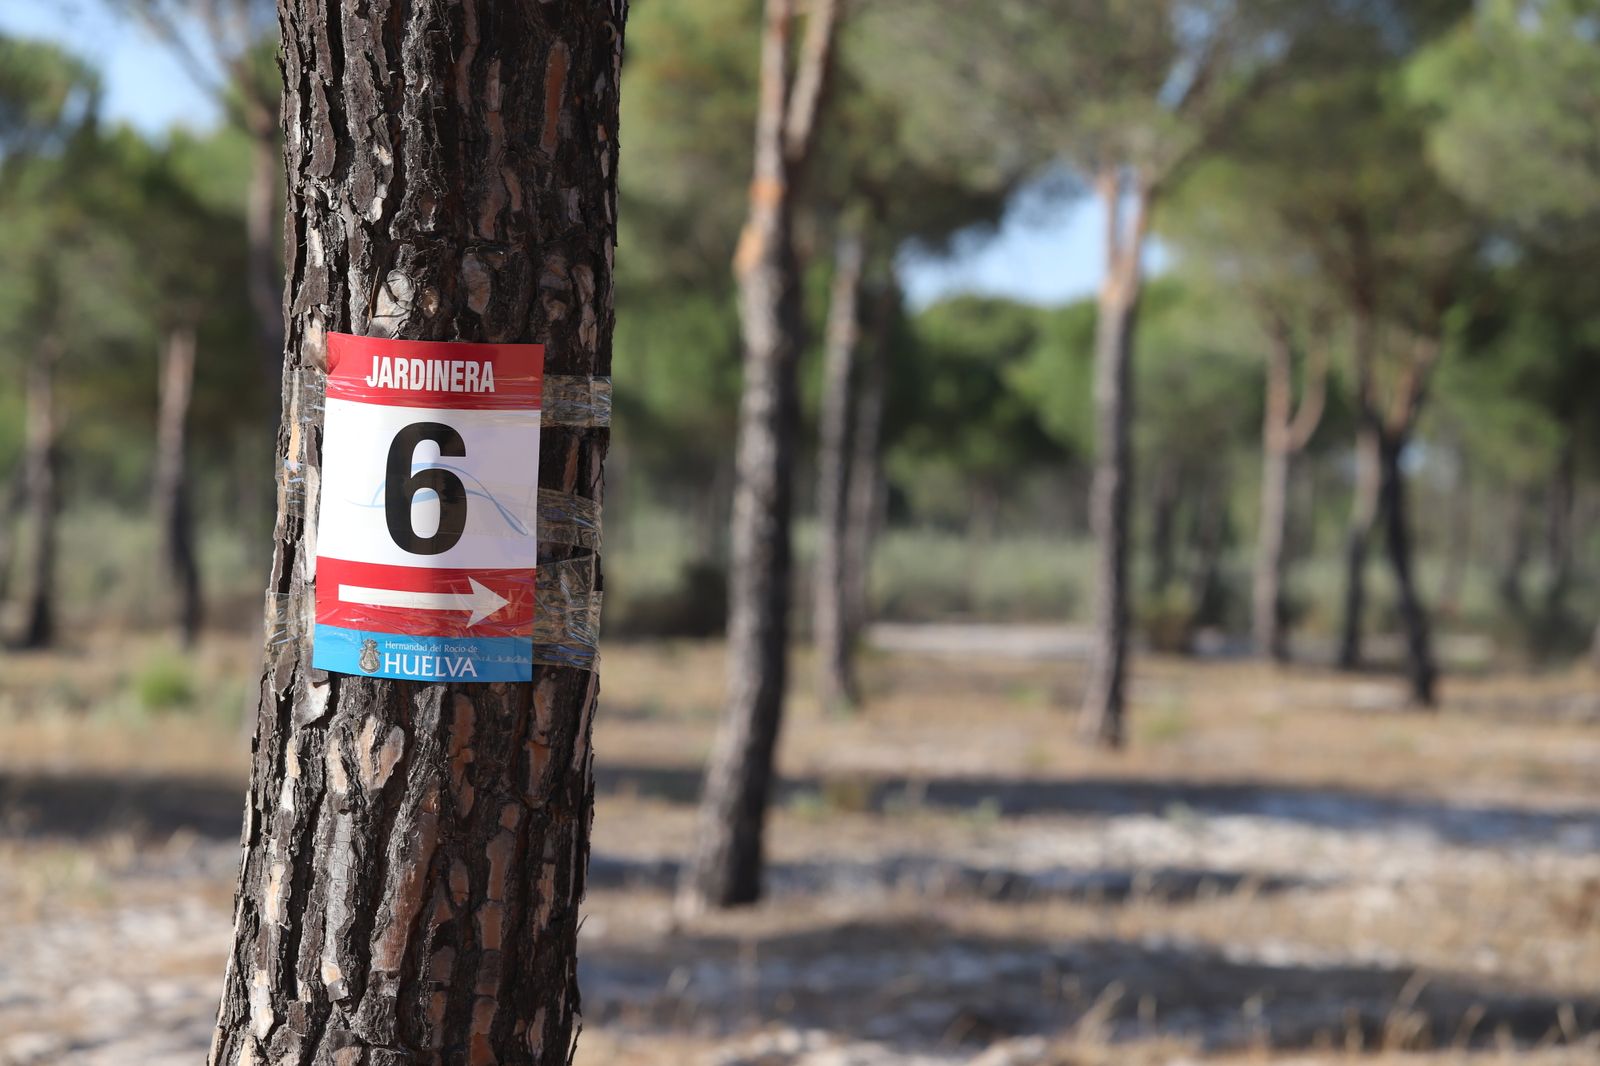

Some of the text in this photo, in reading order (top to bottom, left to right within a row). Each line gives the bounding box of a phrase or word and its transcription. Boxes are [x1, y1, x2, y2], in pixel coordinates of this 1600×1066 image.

[366, 355, 495, 392] JARDINERA
[385, 421, 467, 555] 6
[385, 640, 427, 652] Hermandad
[430, 644, 441, 652] del
[384, 652, 478, 677] HUELVA
